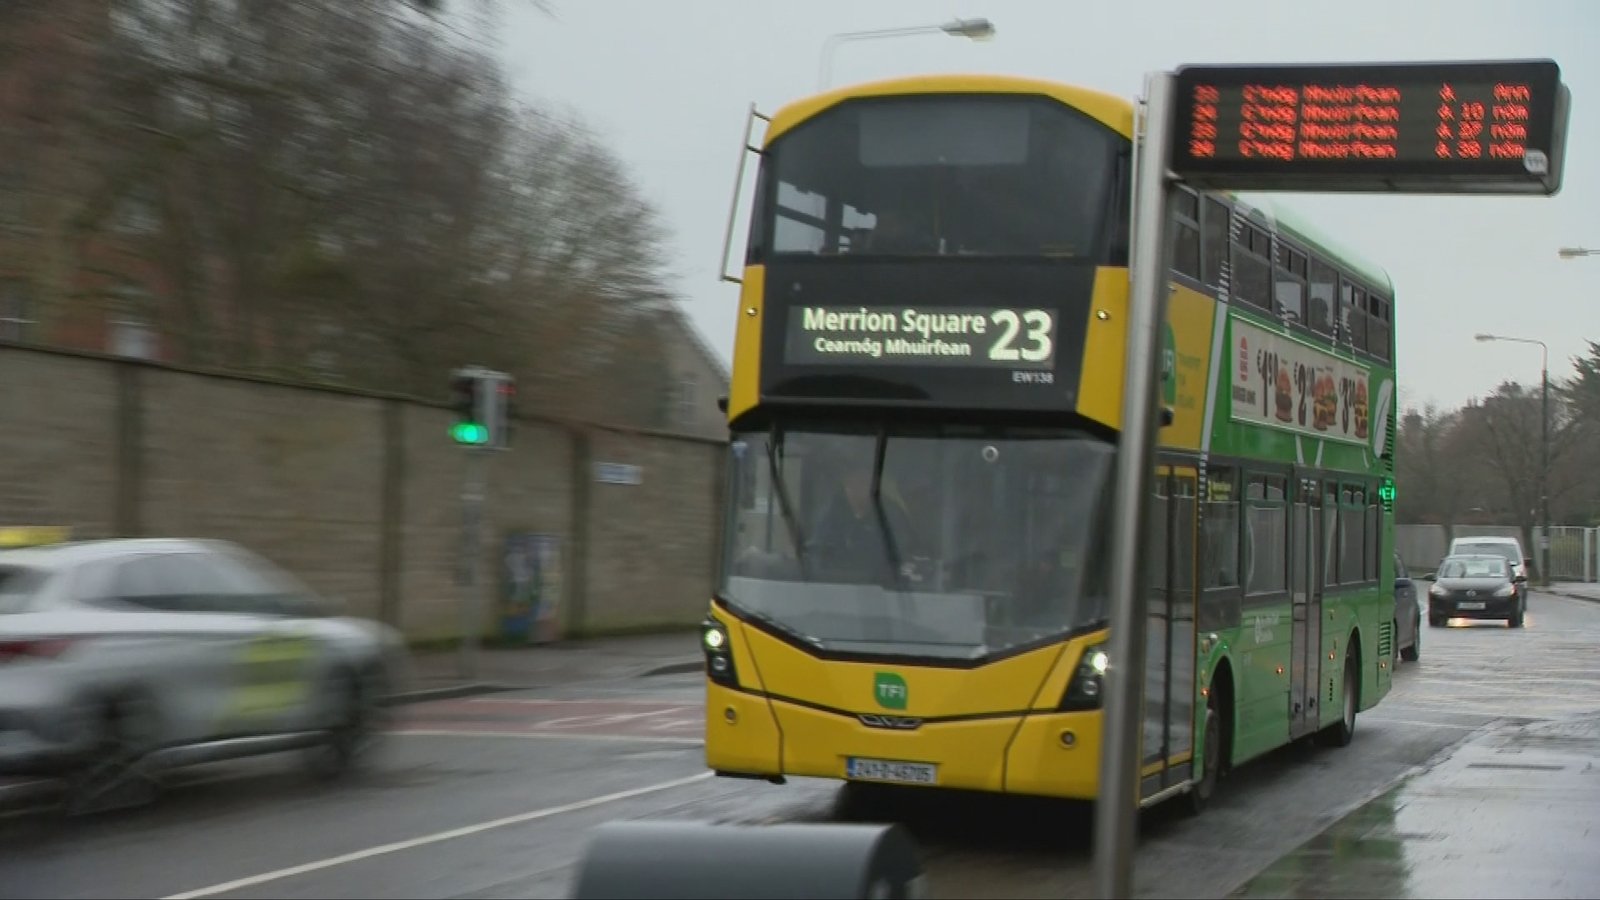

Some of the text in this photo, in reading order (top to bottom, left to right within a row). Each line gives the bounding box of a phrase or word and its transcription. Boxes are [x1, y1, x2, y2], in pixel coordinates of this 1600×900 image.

[1303, 84, 1400, 103] Mhuirfean
[1302, 103, 1399, 122] Mhuirfean
[1301, 121, 1398, 140] Mhuirfean
[1299, 140, 1397, 158] Mhuirfean
[803, 307, 987, 338] Merrion Square
[989, 309, 1052, 361] 23
[814, 337, 972, 358] Cearnóg Mhuirfean
[1012, 370, 1054, 384] EW138
[878, 683, 905, 699] TFI
